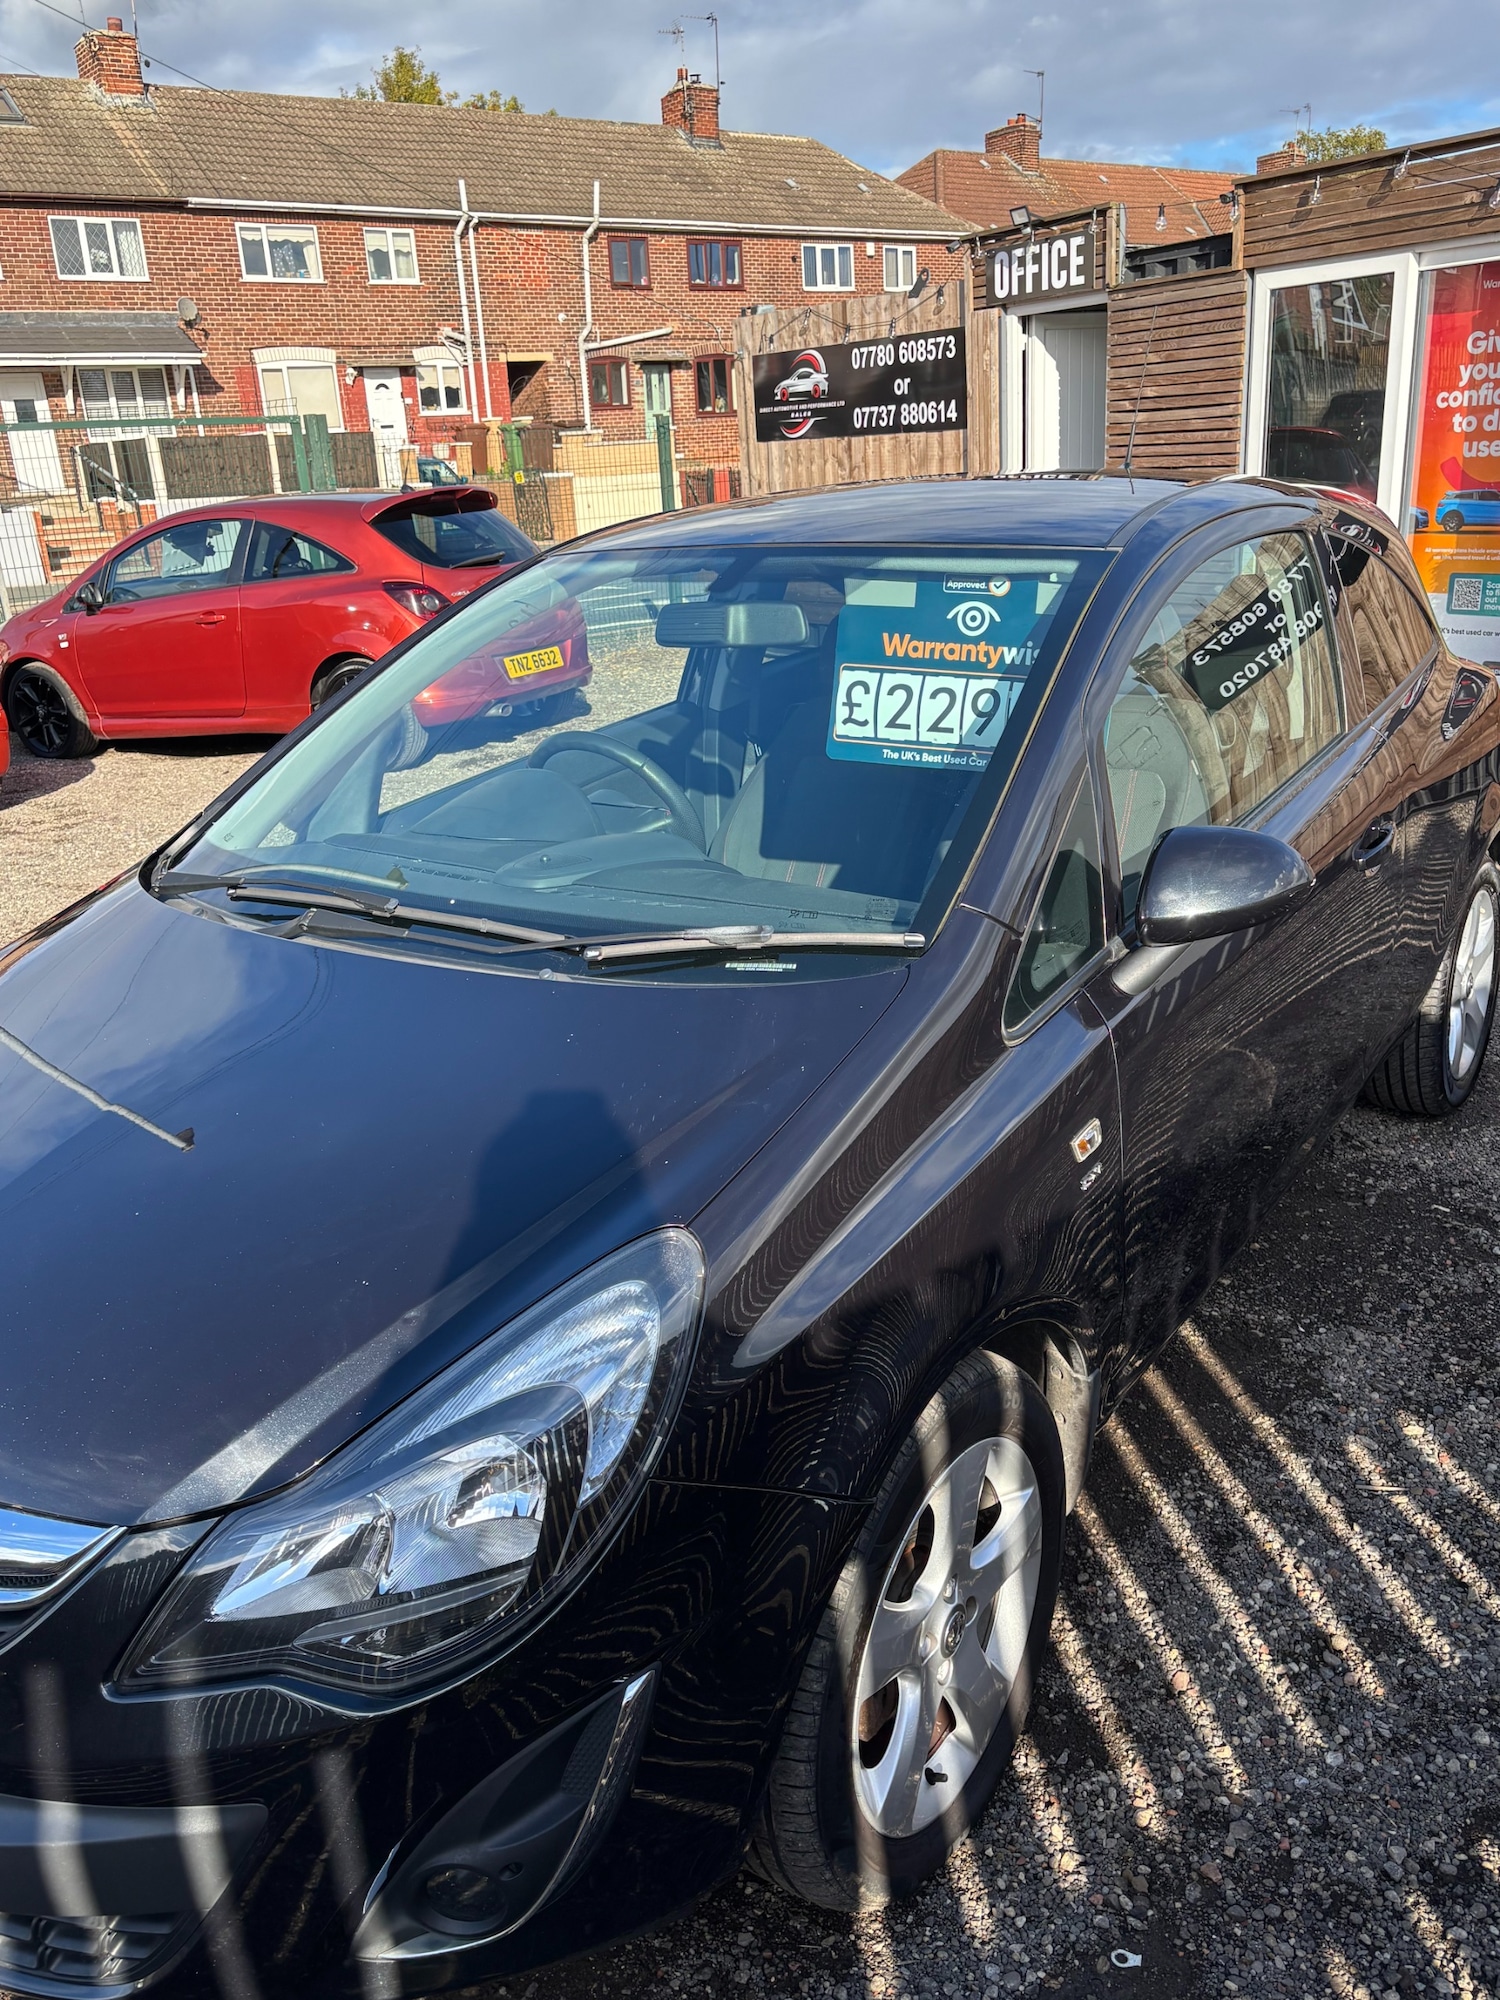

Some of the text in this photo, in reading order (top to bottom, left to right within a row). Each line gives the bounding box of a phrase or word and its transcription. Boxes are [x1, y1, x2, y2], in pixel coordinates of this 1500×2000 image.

[994, 235, 1085, 299] OFFICE
[851, 335, 956, 370] 07780 608573
[893, 377, 911, 396] or
[853, 399, 957, 429] 07737 880614
[1452, 408, 1500, 433] to d
[947, 580, 988, 590] Approved.
[509, 650, 558, 674] TNZ 6632
[882, 749, 987, 766] The UK's Best Used Car
